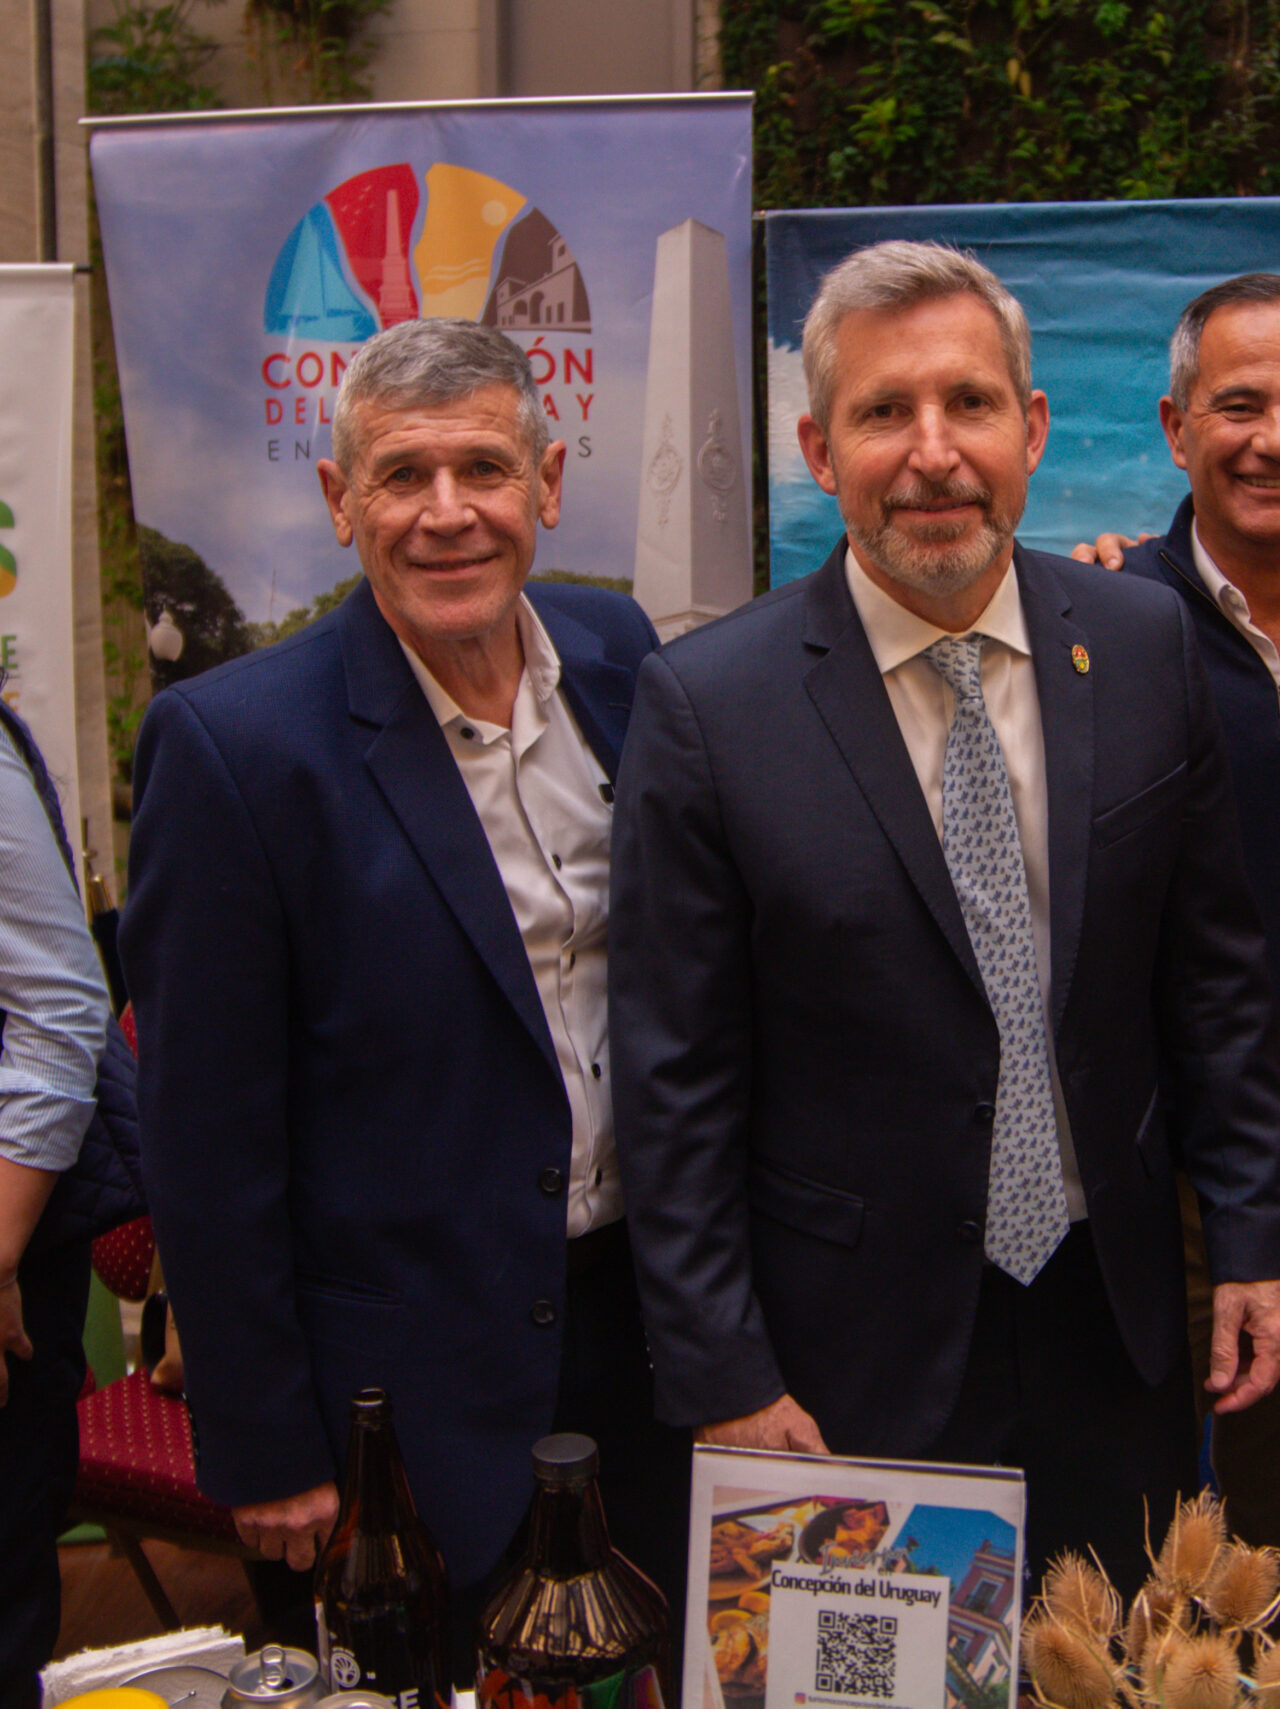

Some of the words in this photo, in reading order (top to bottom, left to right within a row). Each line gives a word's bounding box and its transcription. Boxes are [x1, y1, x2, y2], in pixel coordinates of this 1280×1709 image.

[266, 397, 330, 425] DEL
[268, 440, 310, 461] EN
[772, 1569, 851, 1597] Concepción
[854, 1577, 876, 1598] del
[879, 1579, 942, 1609] Uruguay
